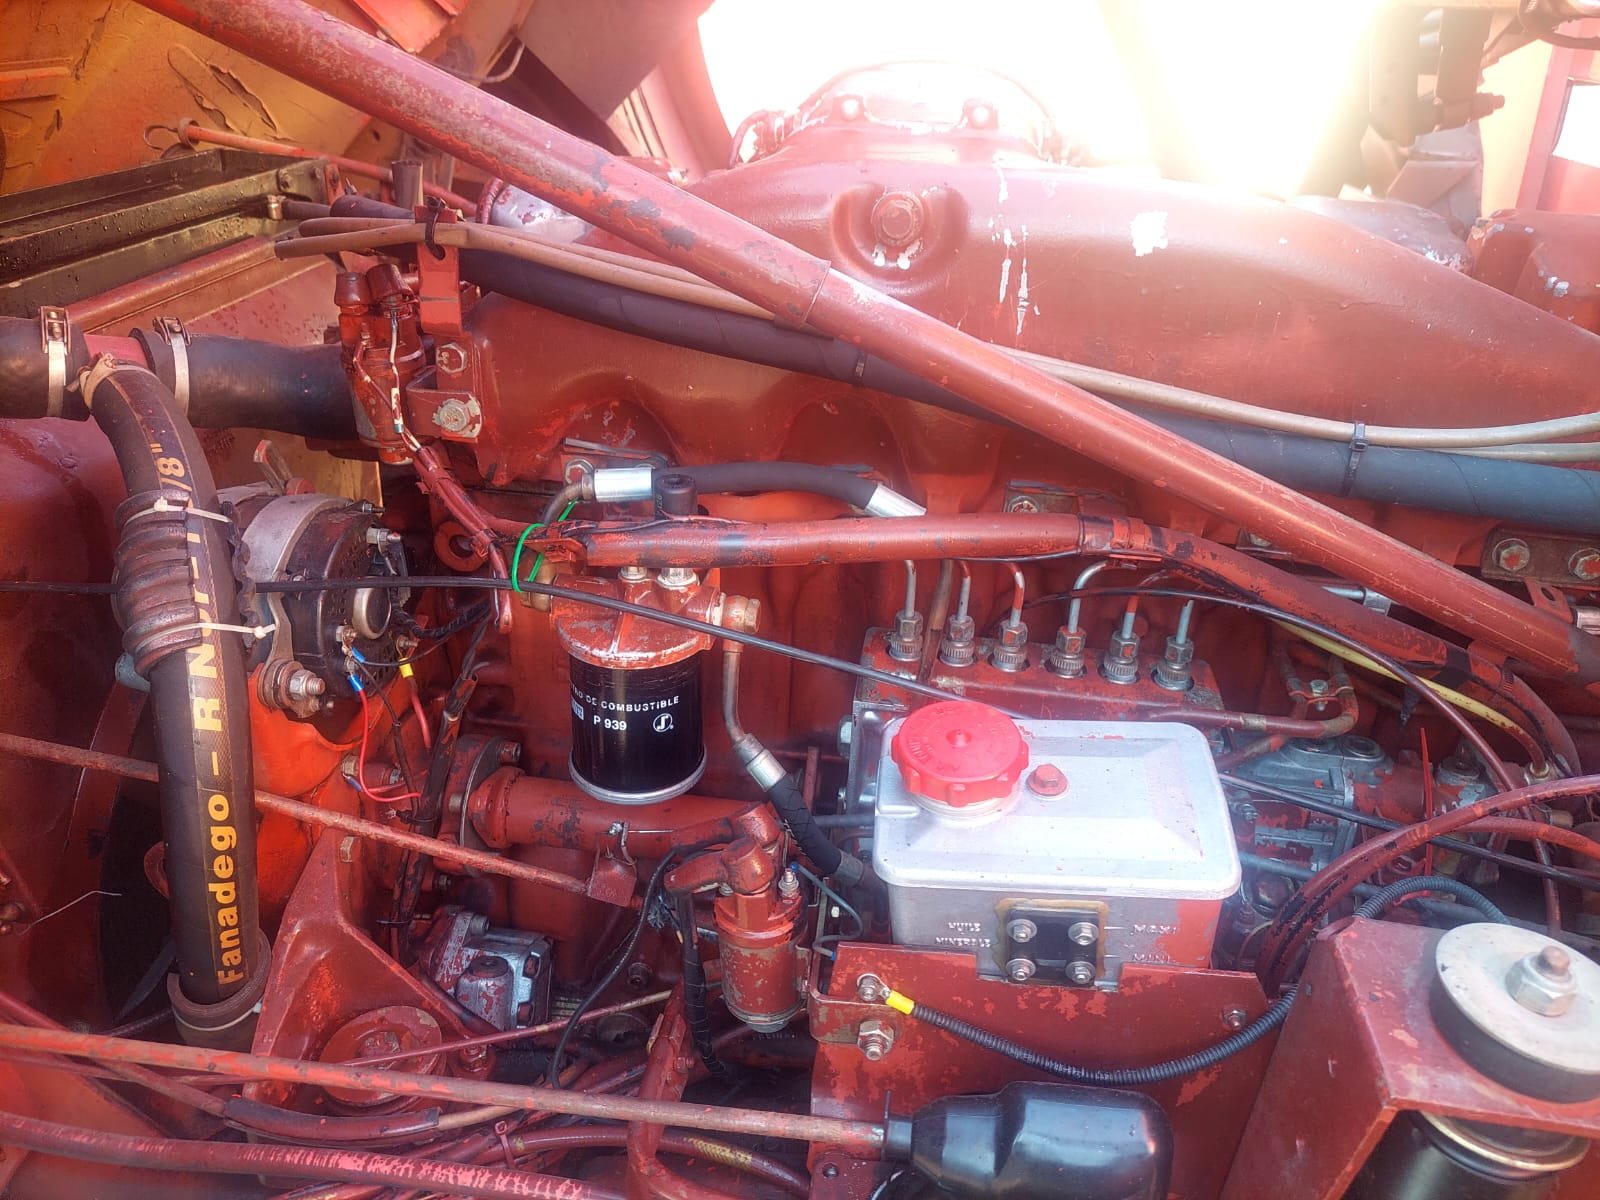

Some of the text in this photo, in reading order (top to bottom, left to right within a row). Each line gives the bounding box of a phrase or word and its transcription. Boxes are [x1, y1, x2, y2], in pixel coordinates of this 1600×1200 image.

[149, 443, 194, 510] /8"
[193, 697, 223, 731] R
[586, 695, 597, 706] DE
[593, 715, 627, 731] P 939
[207, 793, 245, 985] Fanadego
